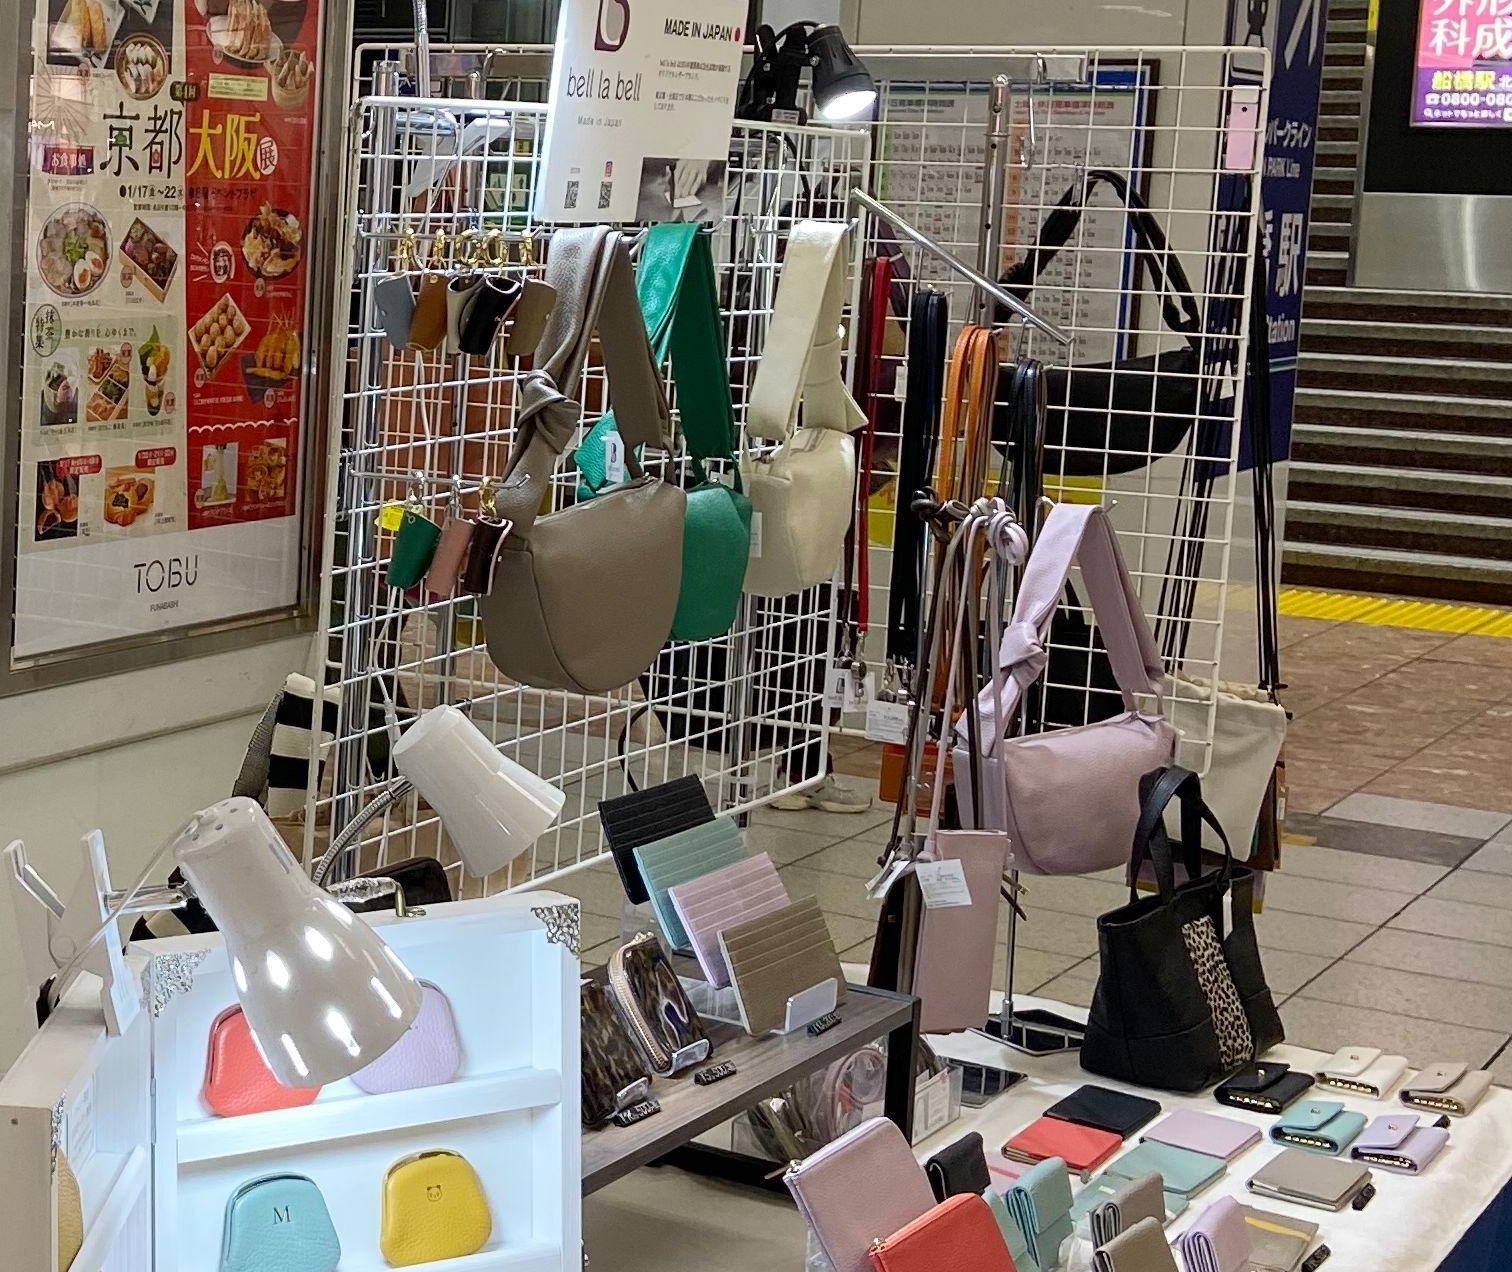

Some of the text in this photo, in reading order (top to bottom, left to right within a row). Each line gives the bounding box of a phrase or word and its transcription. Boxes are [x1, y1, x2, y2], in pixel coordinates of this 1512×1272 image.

[663, 17, 733, 42] MADE IN JAPAN
[566, 67, 595, 98] bell
[597, 69, 610, 100] la
[615, 71, 643, 102] bell
[186, 108, 262, 180] 大阪
[133, 553, 199, 594] TOBU
[150, 600, 179, 613] FUNABASHI
[272, 1204, 292, 1225] M
